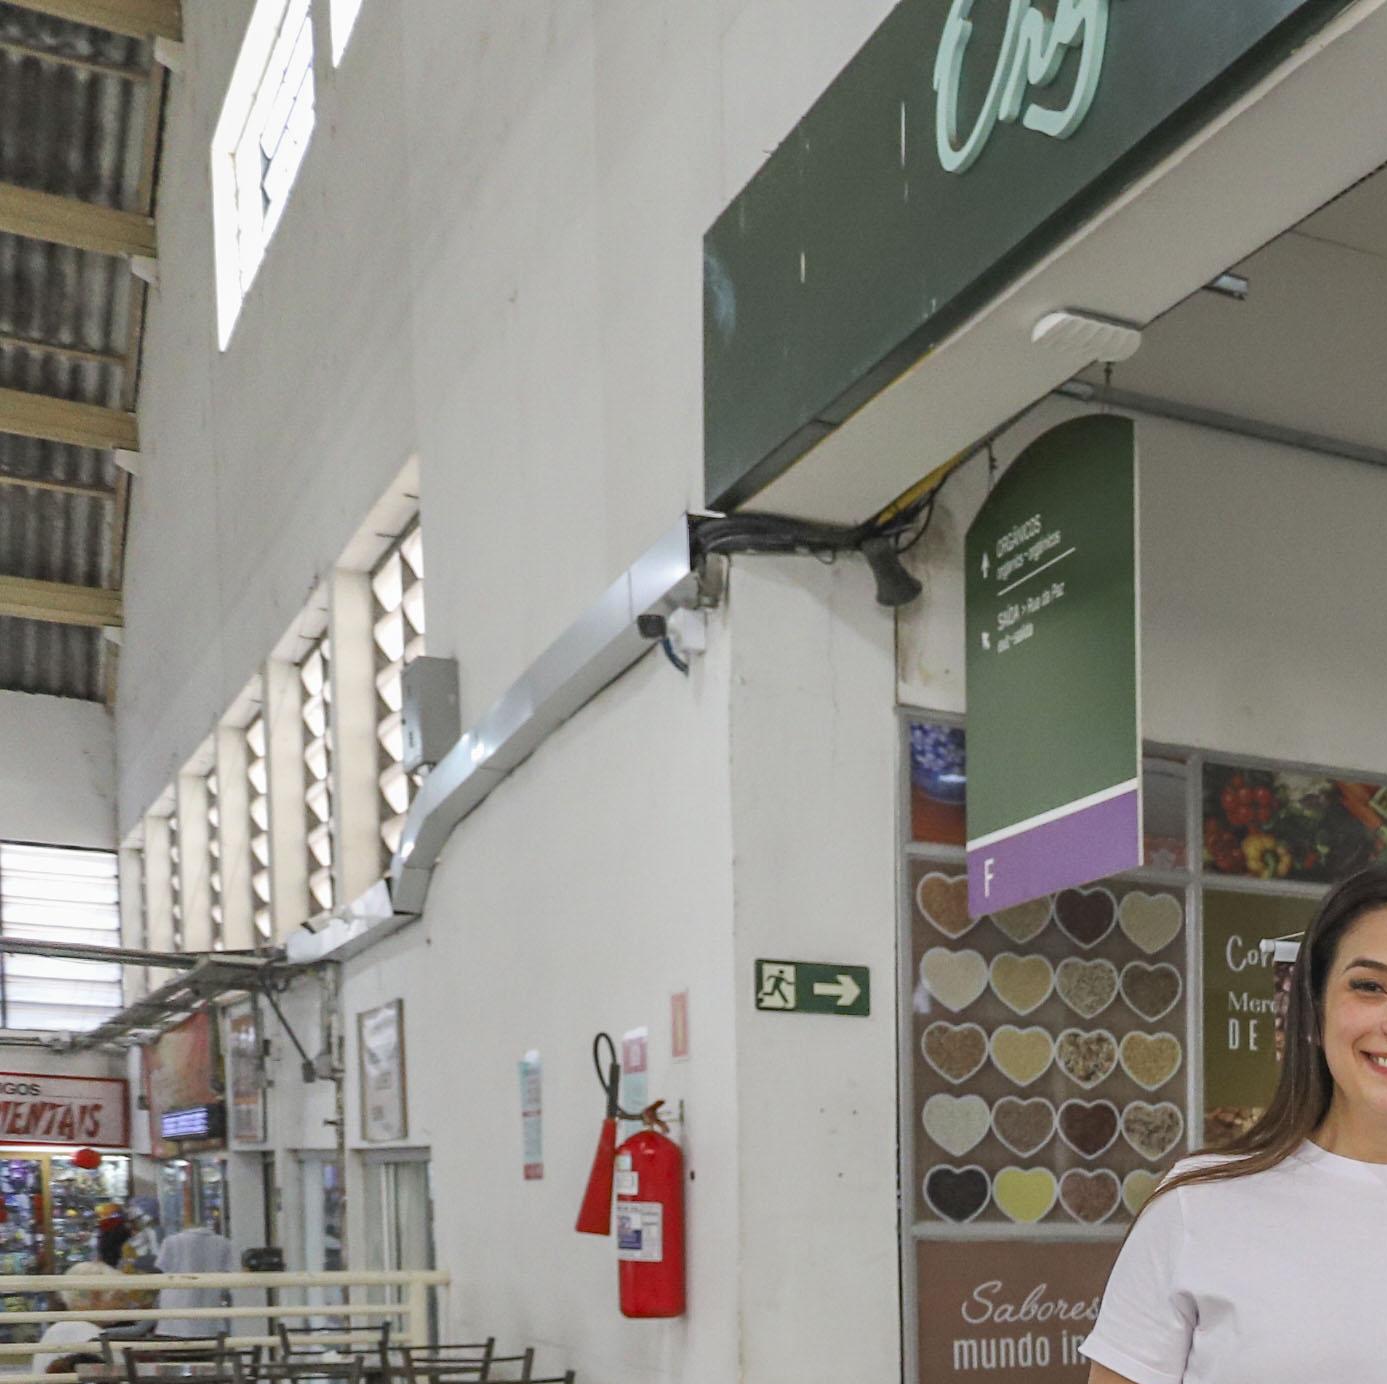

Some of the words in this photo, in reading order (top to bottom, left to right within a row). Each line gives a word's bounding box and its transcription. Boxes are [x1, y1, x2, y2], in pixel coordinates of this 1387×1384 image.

[984, 858, 995, 898] F
[1228, 1018, 1258, 1051] DE
[961, 1279, 1101, 1325] Sabores
[953, 1331, 1050, 1371] mundo
